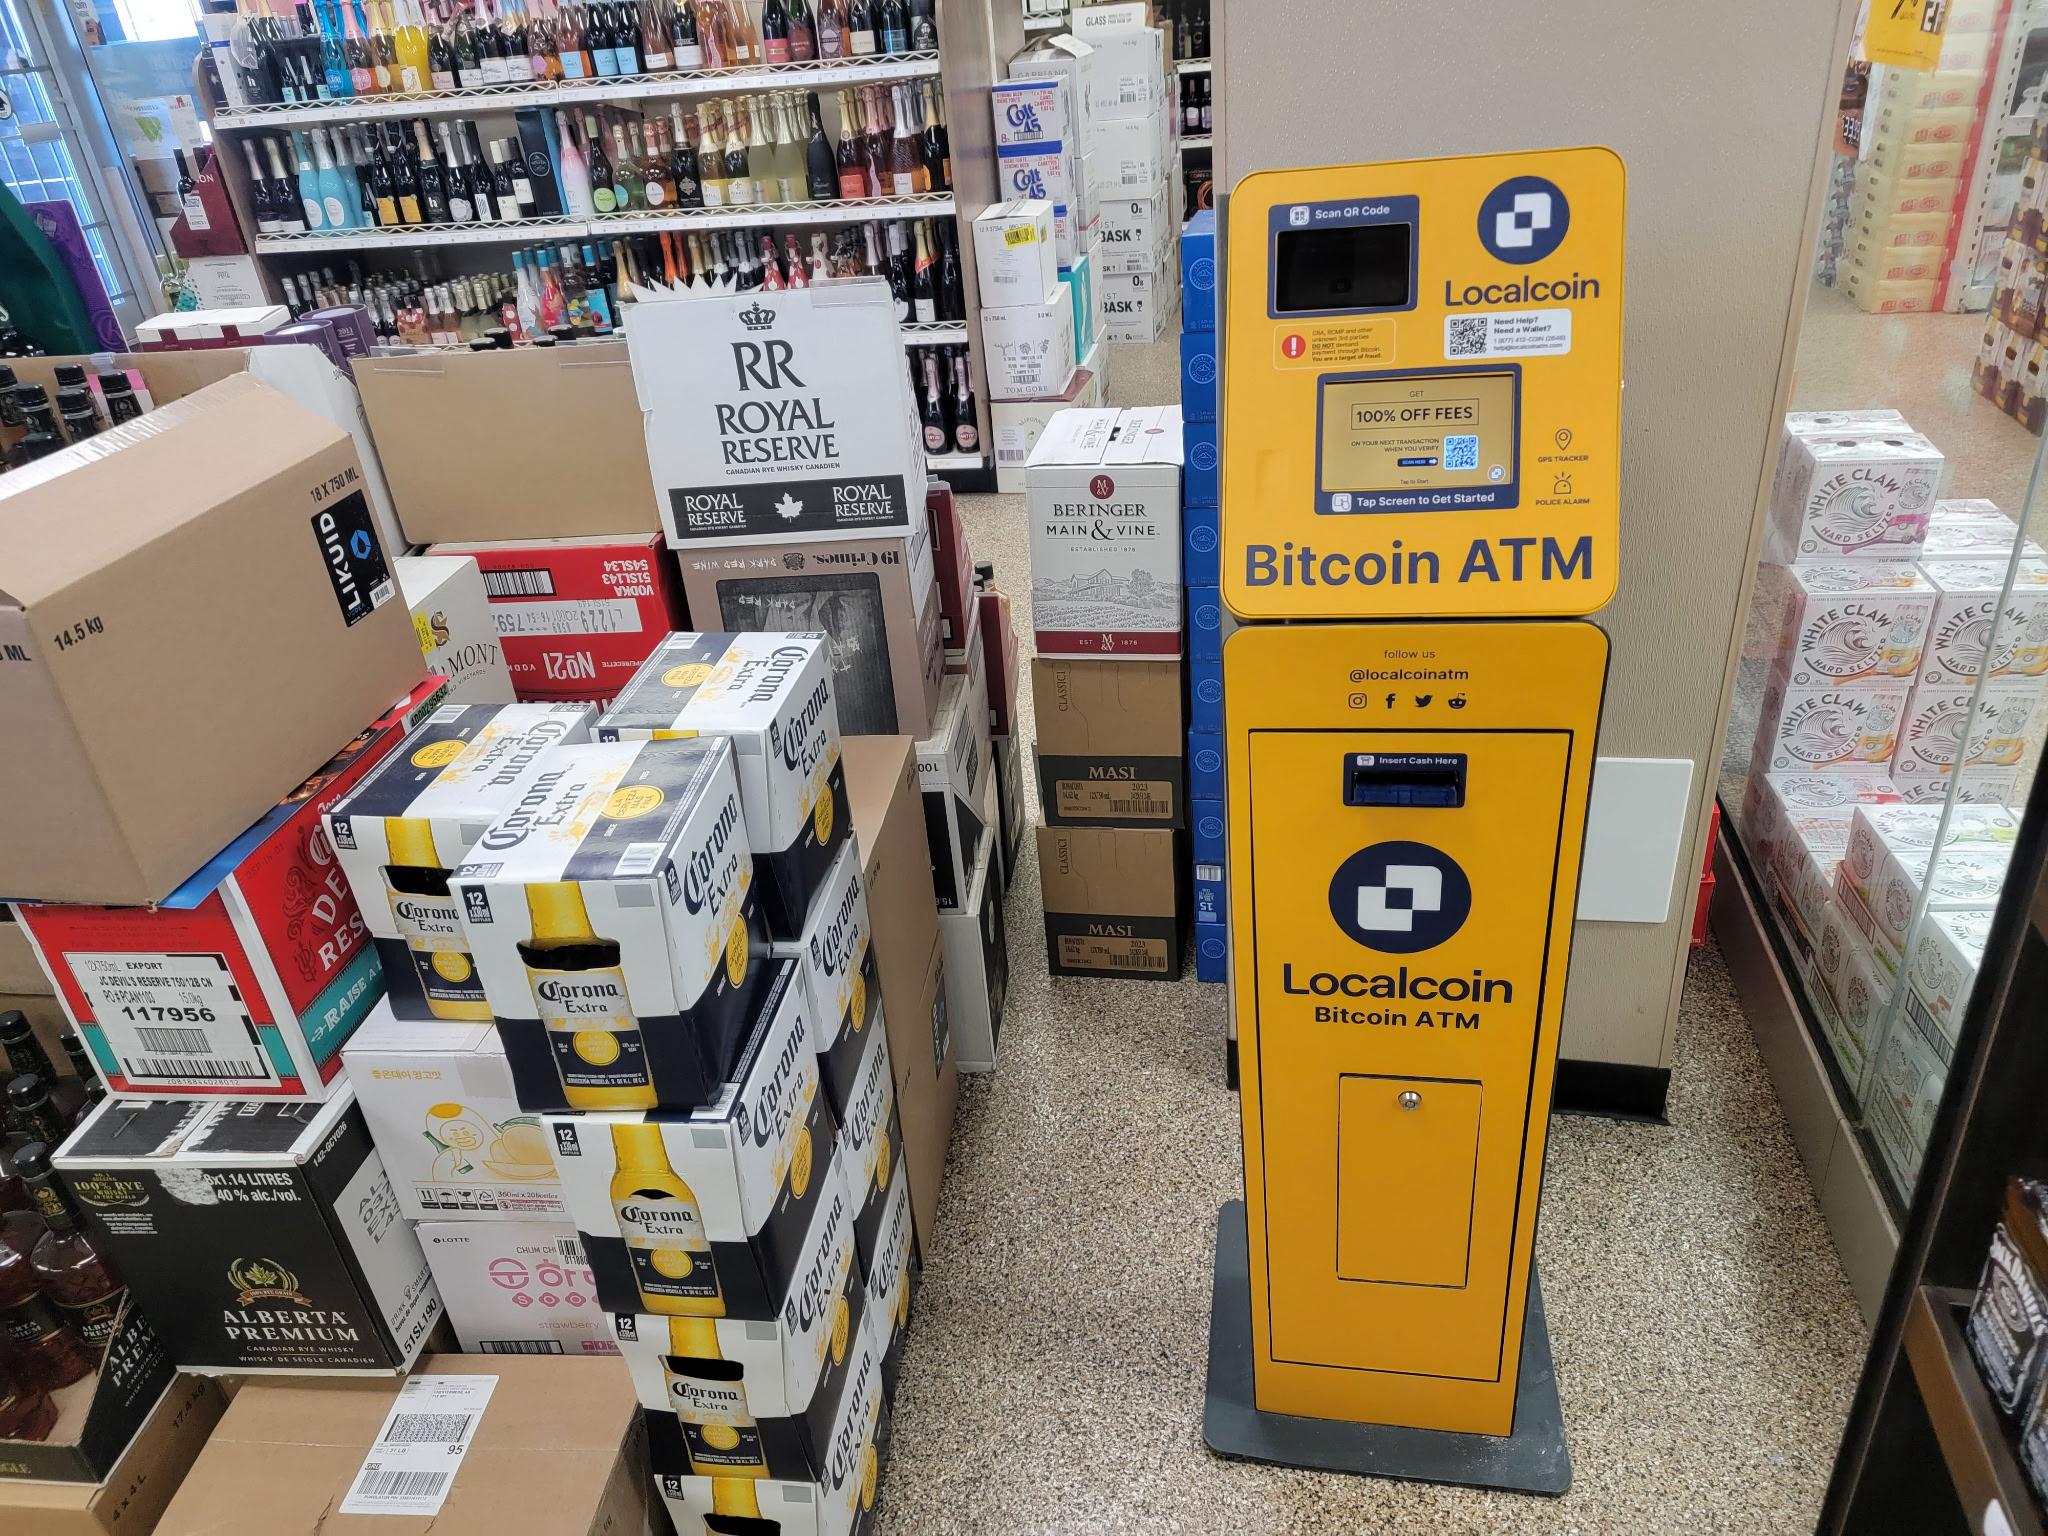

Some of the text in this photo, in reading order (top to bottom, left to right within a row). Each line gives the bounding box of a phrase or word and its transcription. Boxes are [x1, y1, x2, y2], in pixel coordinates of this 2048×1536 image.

[1086, 15, 1107, 27] GLASS
[1007, 103, 1037, 127] Colt
[1023, 118, 1042, 133] 45
[1014, 168, 1042, 192] Colt
[1029, 184, 1046, 200] 45
[1316, 205, 1390, 220] Scan QR Code
[1446, 273, 1600, 306] Localcoin
[1516, 317, 1538, 325] Help?
[1494, 327, 1514, 335] Need
[1522, 325, 1552, 333] Wallet?
[731, 339, 807, 391] RR
[1004, 385, 1049, 394] TOM GORE
[715, 398, 835, 435] ROYAL
[1357, 406, 1473, 423] 100% OFF FEES
[721, 434, 840, 465] RESERVE
[726, 467, 760, 476] CANADIAN
[806, 463, 841, 471] CANADIEN
[310, 465, 360, 504] 18 X 750 ML
[832, 484, 892, 503] ROYAL
[1357, 493, 1495, 508] Tap Screen to Get Started
[1808, 468, 1901, 520] WHITE CLAW
[684, 493, 744, 512] ROYAL
[835, 501, 894, 517] RESERVE
[688, 510, 747, 526] RESERVE
[1054, 503, 1148, 518] BERINGER
[1046, 519, 1156, 541] MAIN & VINE
[320, 512, 363, 611] LIKUID
[604, 560, 649, 571] 54SL34
[691, 551, 901, 571] 19 Crimes. DARK RED WINE
[1246, 536, 1594, 587] Bitcoin ATM
[602, 573, 651, 584] 51SL143
[614, 586, 655, 596] VODKA
[54, 613, 105, 651] 14.5 kg
[1802, 604, 1892, 652] WHITE CLAW
[1384, 650, 1436, 659] follow us
[1350, 668, 1469, 683] @localcoinatm
[1781, 693, 1869, 739] WHITE CLAW
[1379, 756, 1458, 766] Insert Cash Here
[1088, 766, 1137, 780] MASI
[1132, 783, 1148, 791] 2023
[334, 822, 350, 835] 12
[684, 793, 738, 916] Corona
[704, 854, 738, 918] Extra
[466, 892, 483, 906] 12
[1088, 924, 1134, 937] MASI
[1130, 940, 1146, 948] 2023
[126, 962, 163, 970] EXPORT
[109, 976, 136, 987] DEVIL'S
[137, 977, 172, 987] RESERVE
[201, 978, 213, 989] CN
[1283, 963, 1513, 1004] Localcoin
[538, 980, 619, 1004] Corona
[323, 976, 366, 1032] RAISE
[565, 1000, 608, 1014] Extra
[122, 1006, 216, 1022] 117956
[1315, 1006, 1480, 1030] Bitcoin ATM
[558, 1129, 574, 1141] 12
[74, 1181, 145, 1191] 100% RYE
[249, 1172, 293, 1186] LITRES
[217, 1188, 302, 1203] 40 % alc./vol.
[621, 1206, 694, 1225] Corona
[645, 1223, 684, 1235] Extra
[517, 1246, 540, 1254] CHUM
[223, 1310, 345, 1326] ALBERTA
[538, 1320, 599, 1329] strawberry
[618, 1318, 633, 1330] 12
[404, 1298, 438, 1354] 51SL190
[226, 1326, 360, 1342] PREMIUM
[246, 1345, 296, 1353] CANADIAN
[319, 1346, 355, 1354] WHISKY
[239, 1355, 375, 1365] WHISKY DE SEIGLE CANADIEN
[672, 1381, 739, 1401] Corona
[693, 1398, 729, 1411] Extra
[447, 1444, 464, 1455] 95
[665, 1479, 679, 1490] 12
